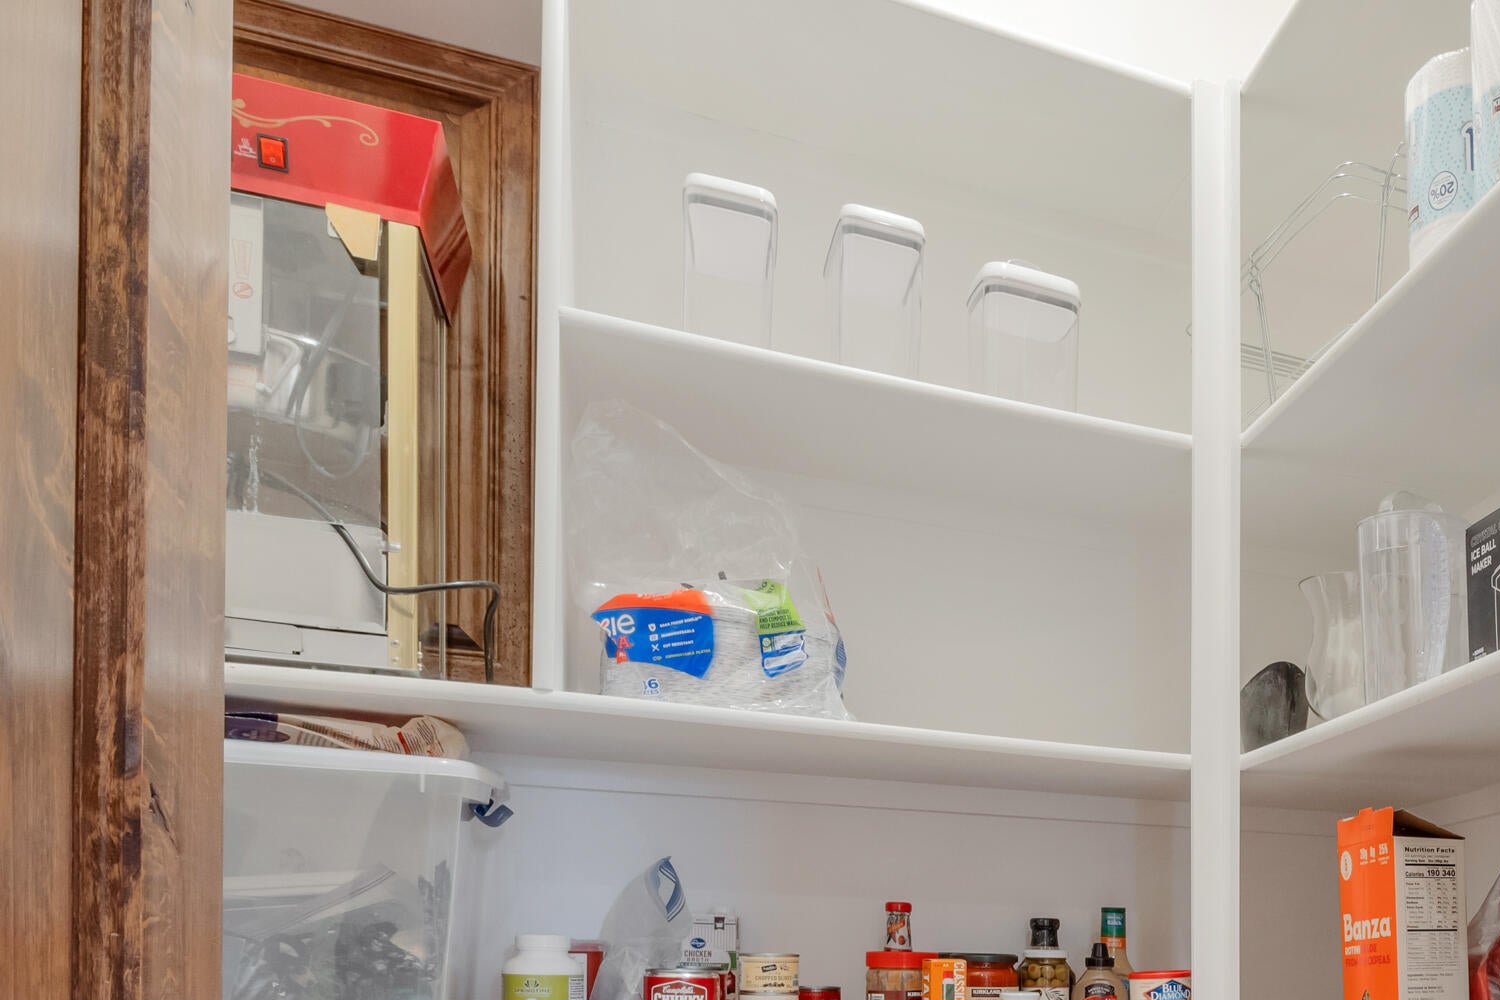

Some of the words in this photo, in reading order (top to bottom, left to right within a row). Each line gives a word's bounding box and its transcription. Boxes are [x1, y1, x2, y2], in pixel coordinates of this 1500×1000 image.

[1430, 180, 1455, 200] 20%
[1470, 545, 1481, 560] ICE
[1479, 539, 1497, 555] BALL
[1471, 556, 1492, 576] MAKER
[1427, 869, 1440, 877] 190
[1442, 869, 1456, 877] 340
[1343, 913, 1392, 942] Banza
[684, 950, 712, 958] CHICKEN
[1150, 989, 1190, 1000] DIAMOND
[1162, 983, 1182, 993] BLUE
